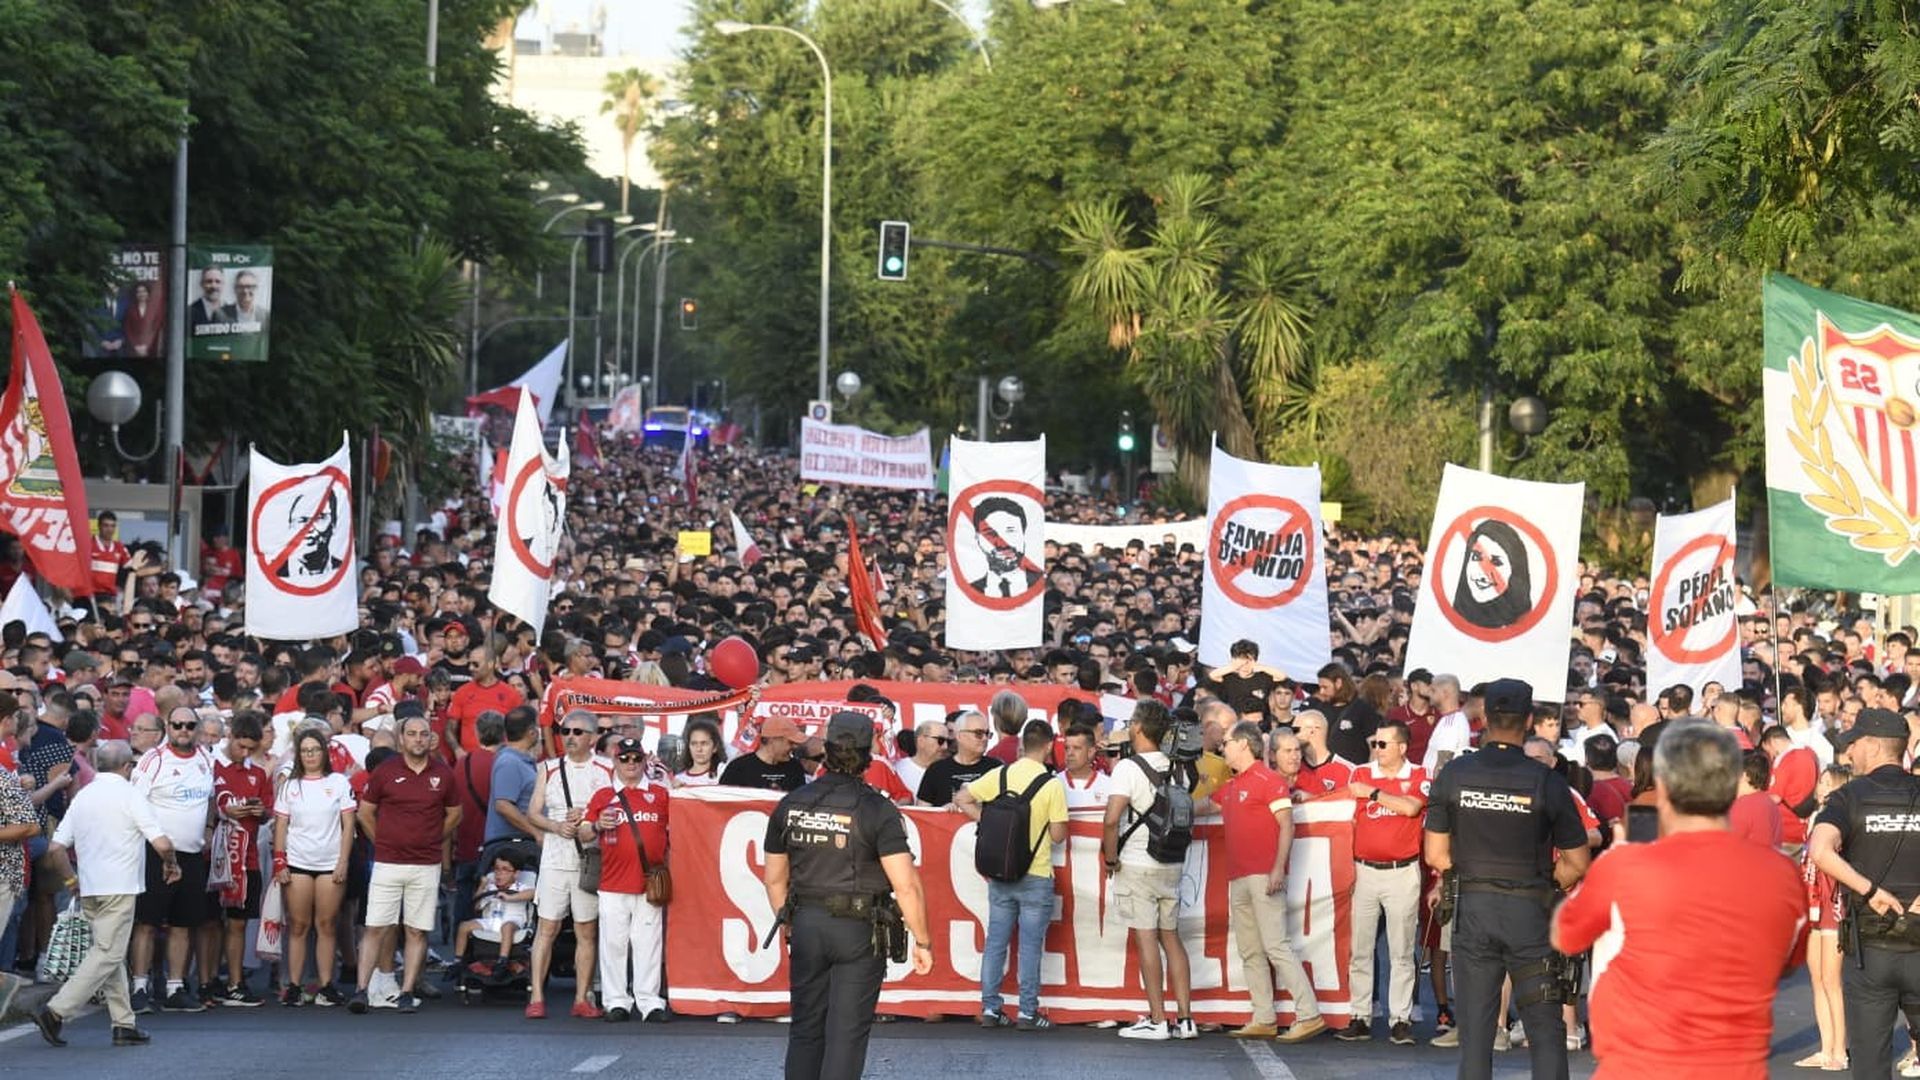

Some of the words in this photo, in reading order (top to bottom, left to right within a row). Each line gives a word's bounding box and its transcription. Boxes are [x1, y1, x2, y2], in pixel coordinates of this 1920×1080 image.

[122, 251, 141, 265] NO
[144, 251, 160, 264] TE
[195, 323, 229, 335] SENTIDO
[1224, 521, 1303, 557] FAMILIA
[1252, 554, 1304, 580] NIDO
[1665, 584, 1735, 632] SOLANO
[769, 703, 816, 718] CORIA
[1460, 799, 1532, 814] NACIONAL
[617, 810, 658, 822] Mdea
[787, 819, 850, 834] NACIONAL
[791, 832, 828, 843] UIP
